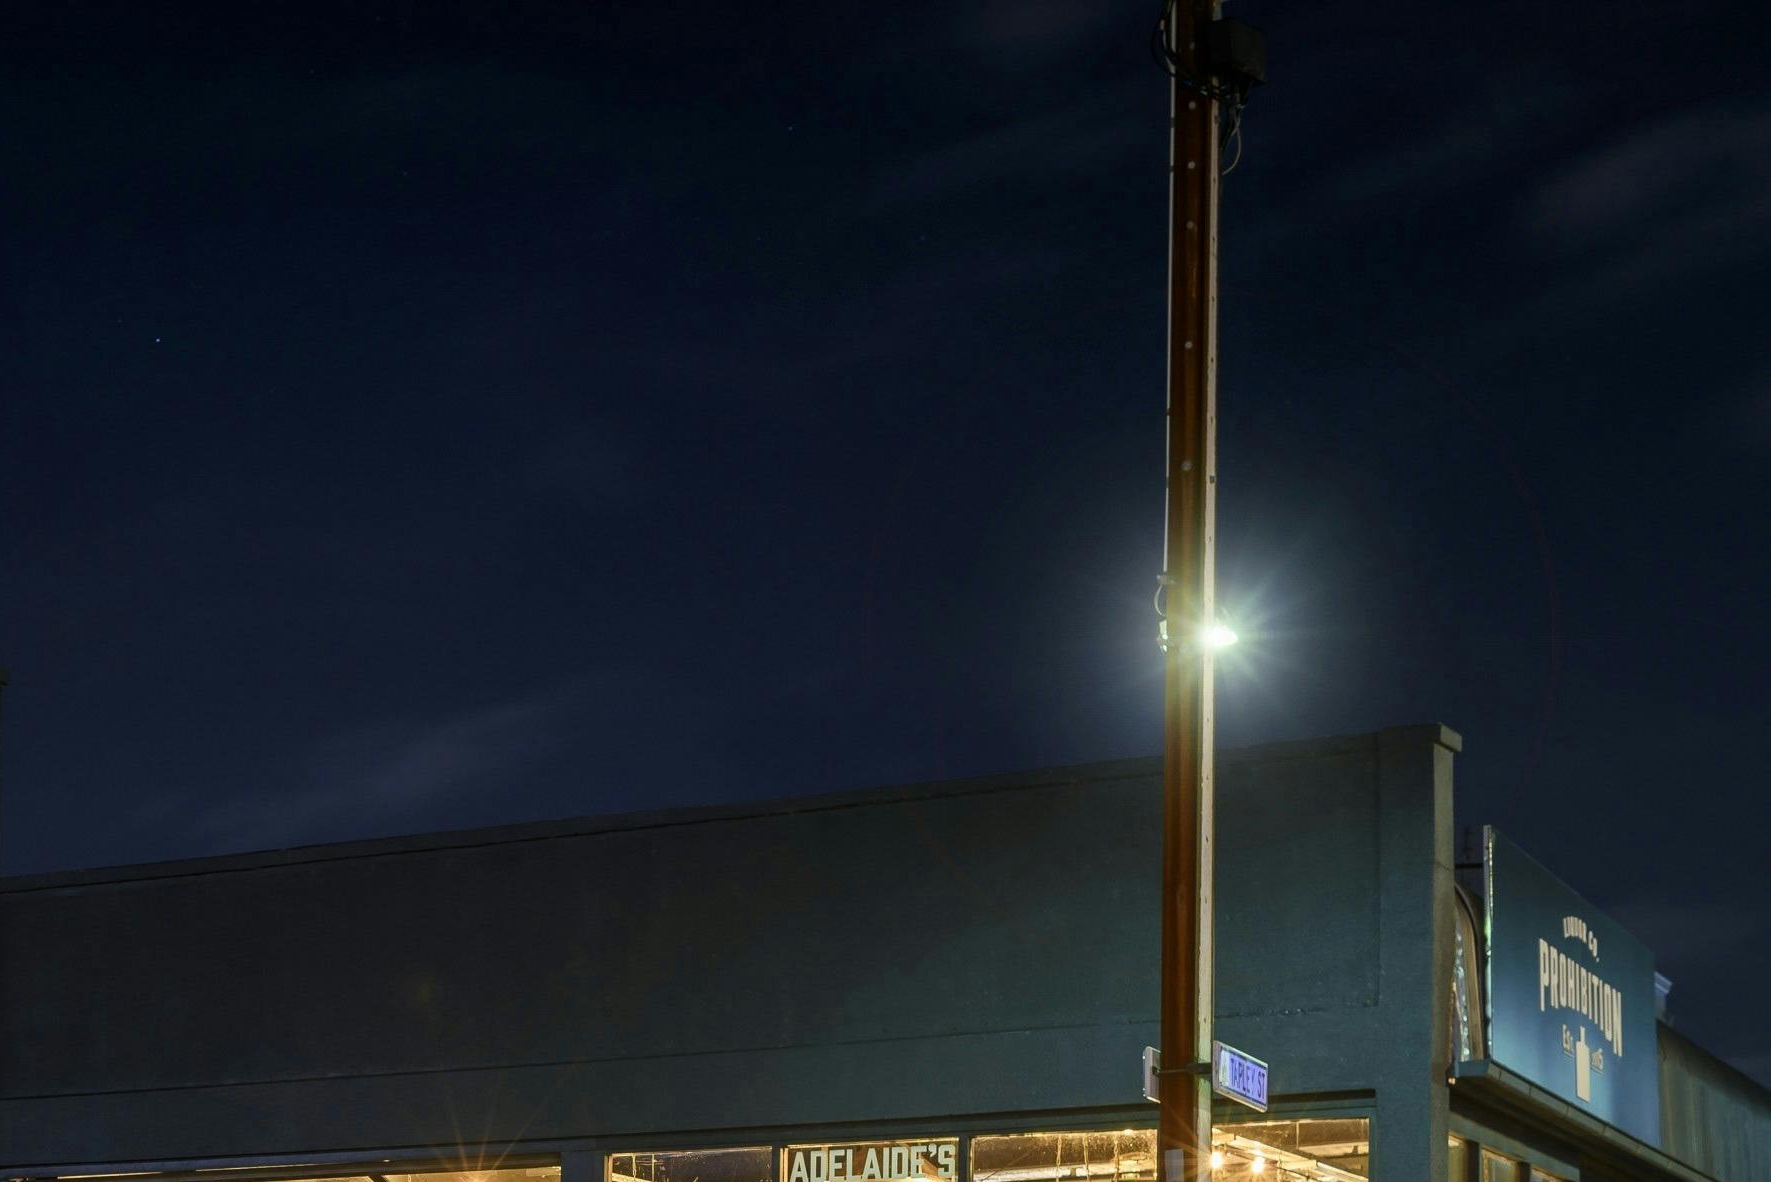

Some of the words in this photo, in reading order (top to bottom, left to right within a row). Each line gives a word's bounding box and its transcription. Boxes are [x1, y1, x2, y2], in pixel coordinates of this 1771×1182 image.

[1539, 938, 1622, 1057] PROHIBITION
[1230, 1058, 1256, 1095] TAPLEY
[1257, 1071, 1265, 1099] ST
